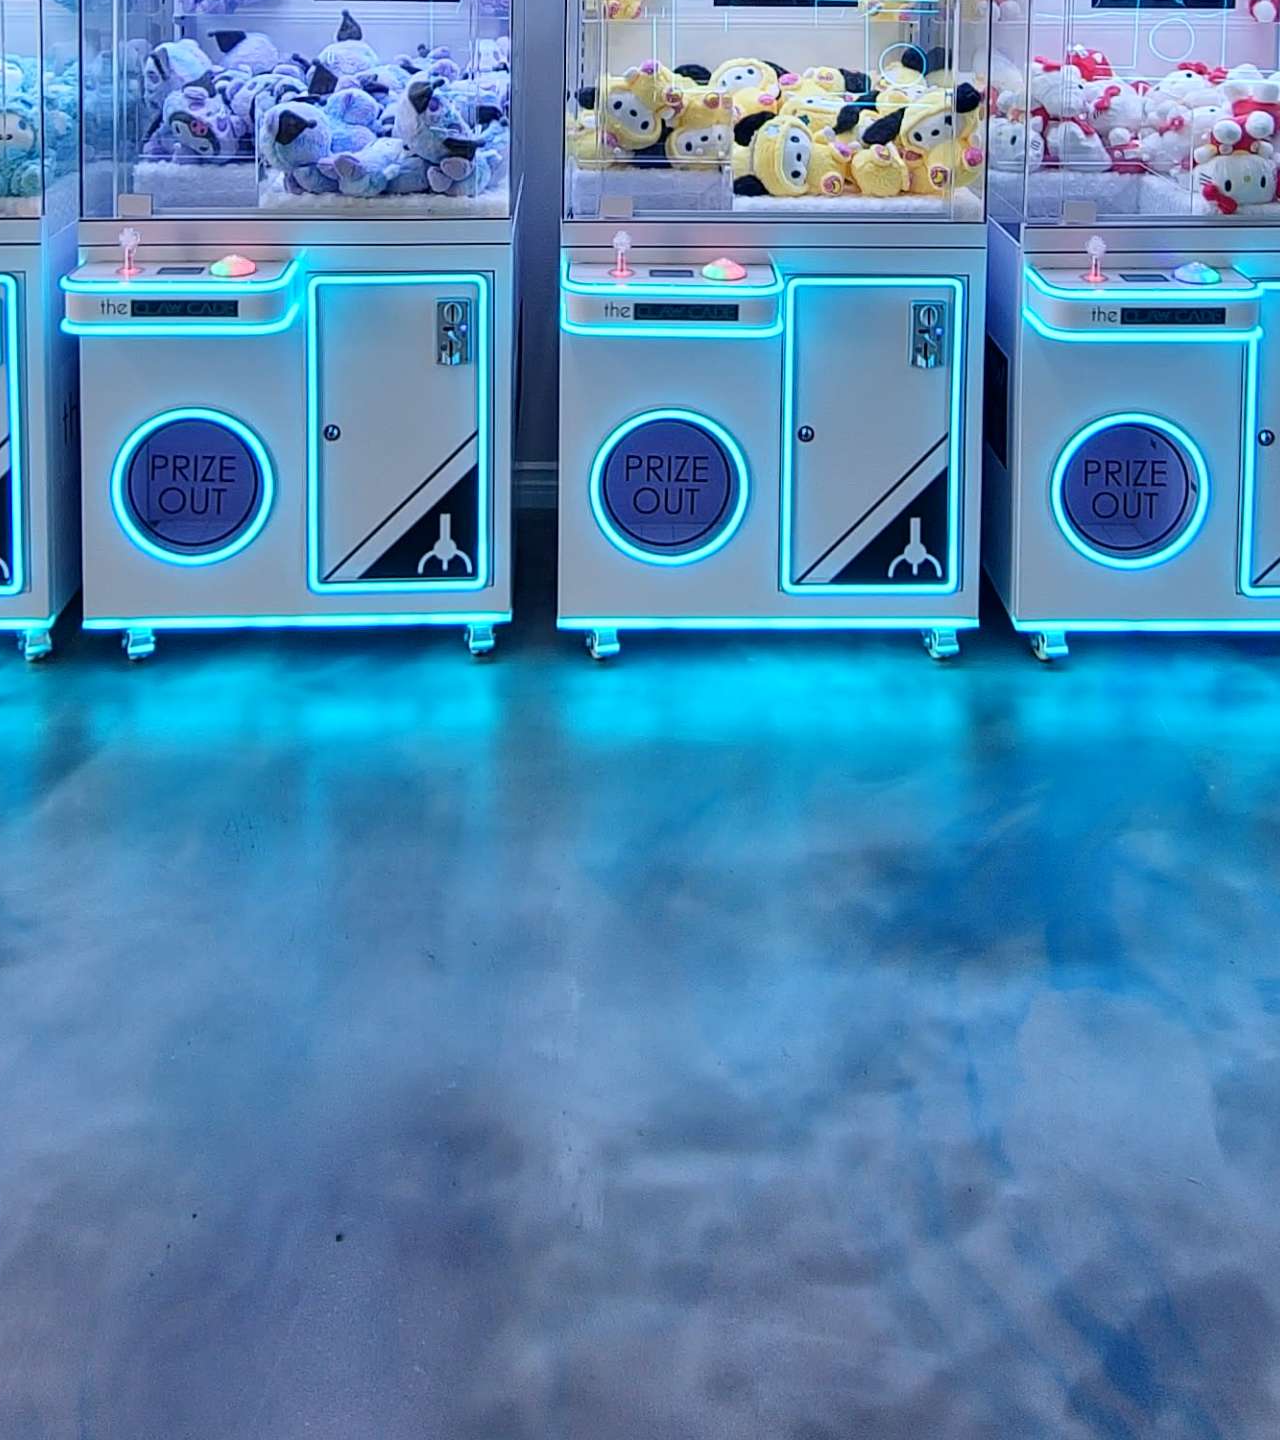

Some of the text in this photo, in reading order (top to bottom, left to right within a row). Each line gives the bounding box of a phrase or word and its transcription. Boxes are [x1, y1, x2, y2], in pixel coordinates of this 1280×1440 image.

[100, 299, 128, 316] the
[604, 302, 631, 319] the
[1091, 307, 1118, 323] the
[150, 454, 237, 482] PRIZE
[625, 455, 709, 482] PRIZE
[1084, 460, 1167, 487] PRIZE
[158, 487, 227, 515] OUT
[633, 487, 700, 515] OUT
[1092, 492, 1159, 519] OUT
